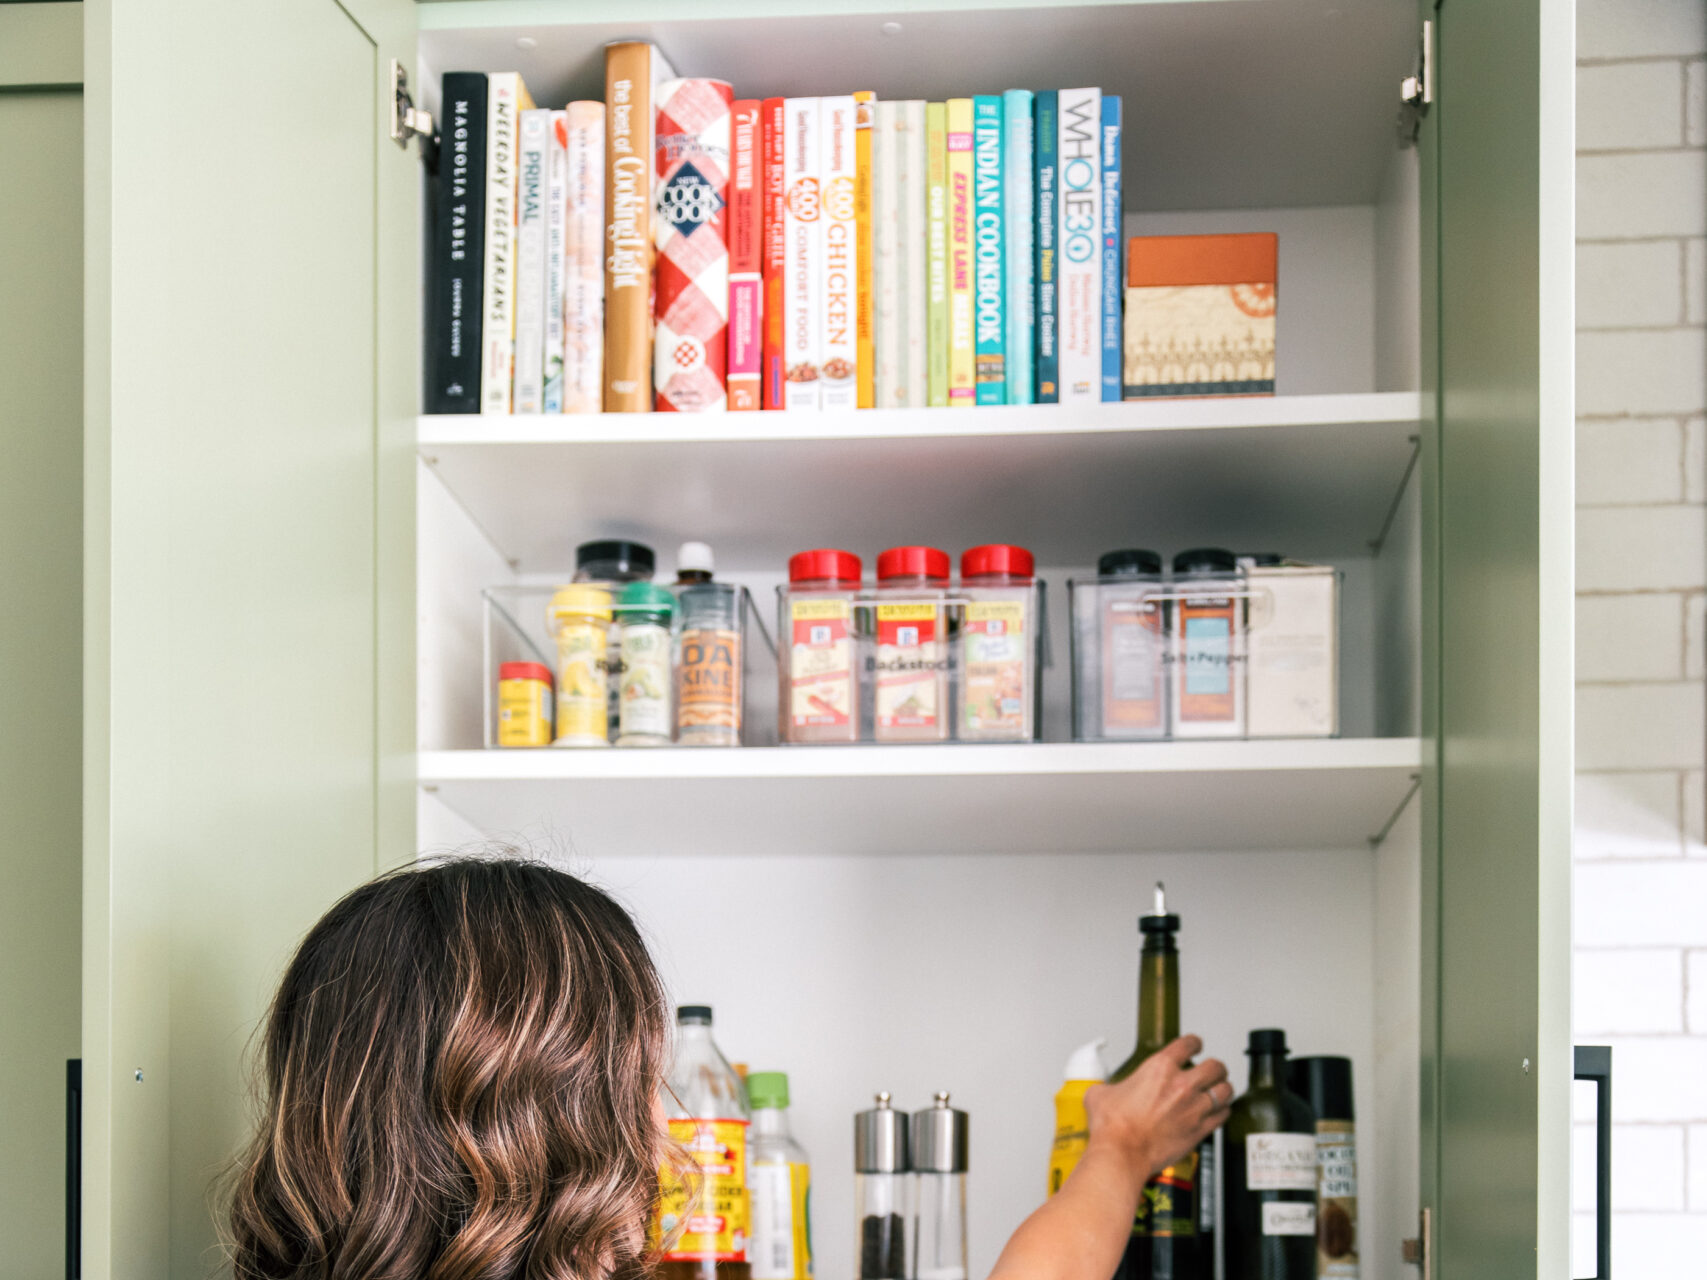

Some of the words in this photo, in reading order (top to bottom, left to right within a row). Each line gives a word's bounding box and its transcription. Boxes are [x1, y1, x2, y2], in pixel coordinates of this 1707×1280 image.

[614, 79, 633, 104] the
[977, 104, 997, 117] THE
[613, 106, 633, 136] best
[453, 101, 468, 197] MAGNOLIA
[496, 102, 512, 188] WEEKDAY
[612, 137, 632, 158] of
[1103, 125, 1119, 166] Damn
[522, 151, 542, 222] PRIMAL
[977, 128, 1001, 209] INDIAN
[1040, 166, 1054, 189] The
[1063, 98, 1095, 263] WHOLE30
[799, 180, 819, 221] 400
[833, 180, 856, 221] 400
[930, 186, 944, 219] OUR
[953, 171, 969, 243] EXPRESS
[1039, 192, 1054, 248] Complete
[1103, 171, 1121, 234] Delicious
[451, 204, 466, 261] TABLE
[771, 222, 784, 269] GRILL
[930, 222, 944, 258] BEST
[491, 194, 511, 322] VEGETARIANS
[796, 225, 810, 301] COMFORT
[953, 249, 968, 290] LANE
[1040, 249, 1053, 282] Paleo
[827, 223, 849, 346] CHICKEN
[931, 261, 944, 303] BITES
[975, 214, 1001, 344] COOKBOOK
[1040, 283, 1053, 312] Slow
[795, 307, 809, 351] FOOD
[1040, 315, 1053, 356] Cooker
[682, 643, 734, 666] DA
[864, 654, 959, 673] Backstock
